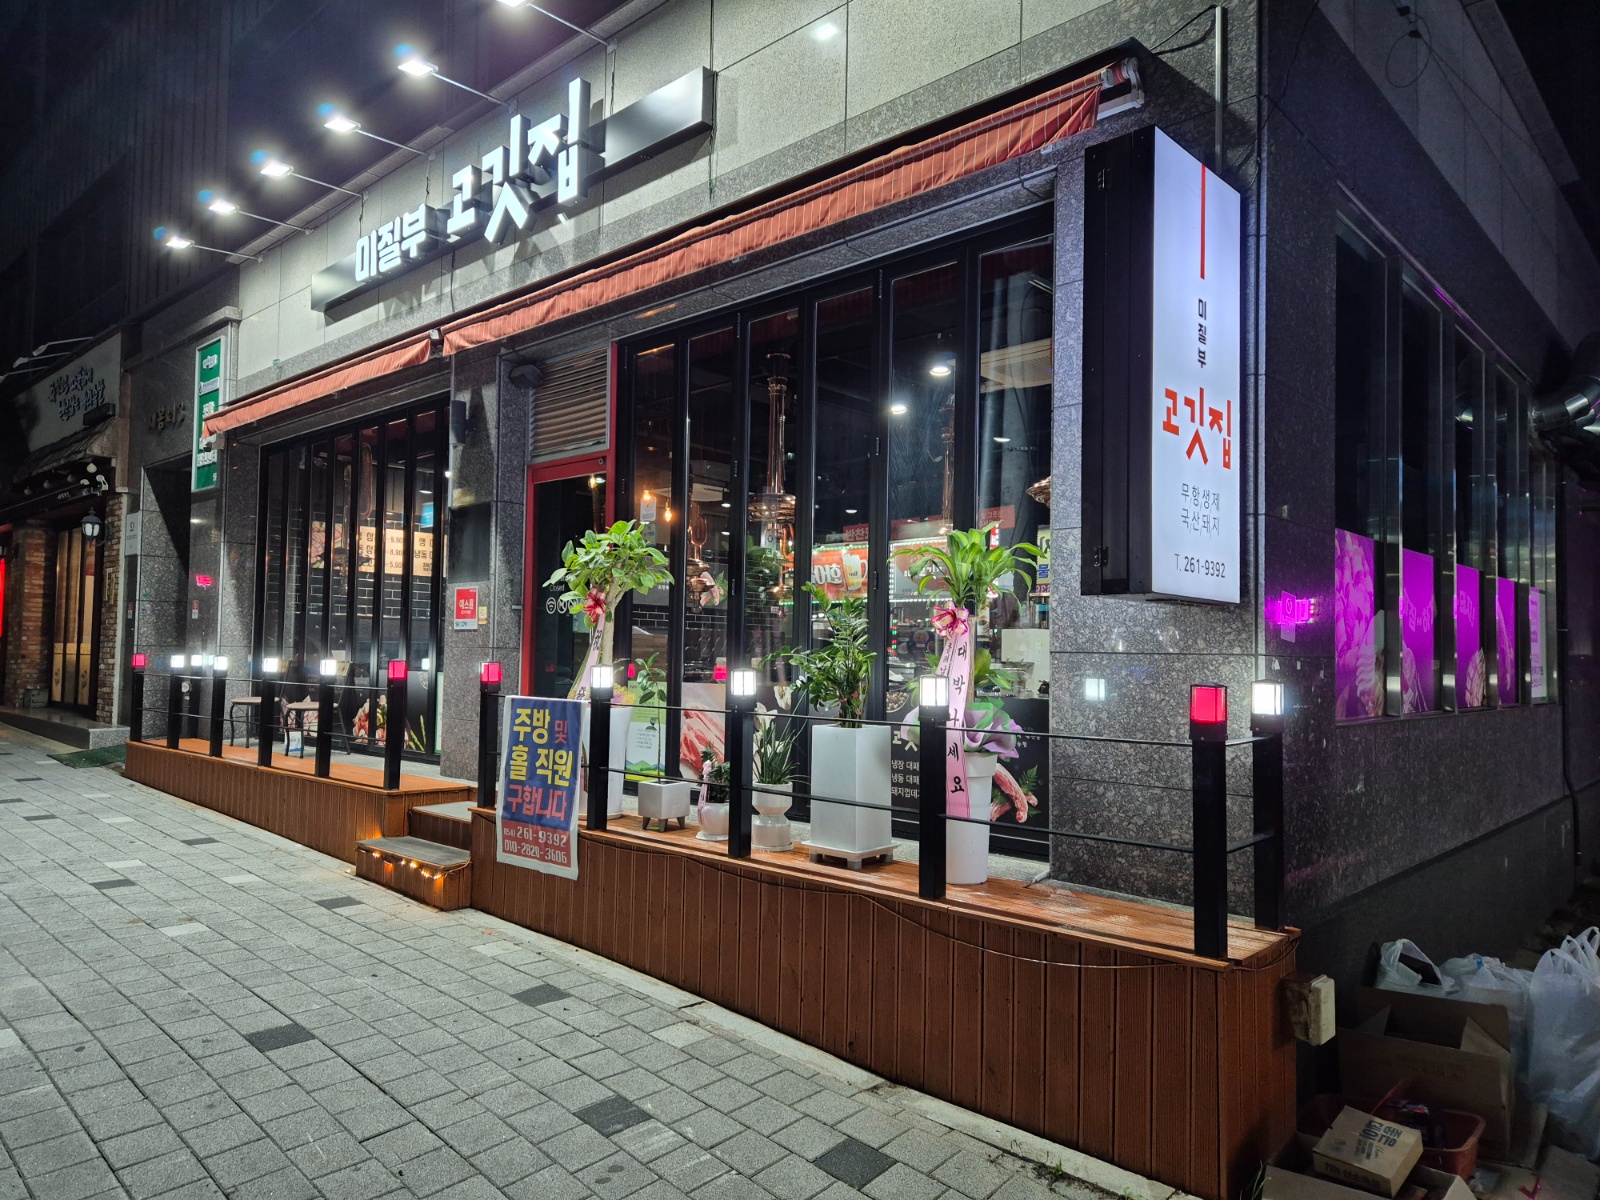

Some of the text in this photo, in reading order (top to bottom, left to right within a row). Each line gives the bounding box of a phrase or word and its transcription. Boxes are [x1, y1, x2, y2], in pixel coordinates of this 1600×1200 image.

[355, 77, 588, 282] 미질부 고깃집
[1197, 298, 1208, 369] 미질부
[1161, 386, 1233, 470] 고깃집
[513, 708, 568, 745] 주방 및
[509, 744, 573, 787] 홀 직원
[891, 759, 904, 770] 냉장
[891, 773, 904, 784] 냉동
[507, 784, 568, 822] 구합니다
[516, 826, 567, 848] 261-9392
